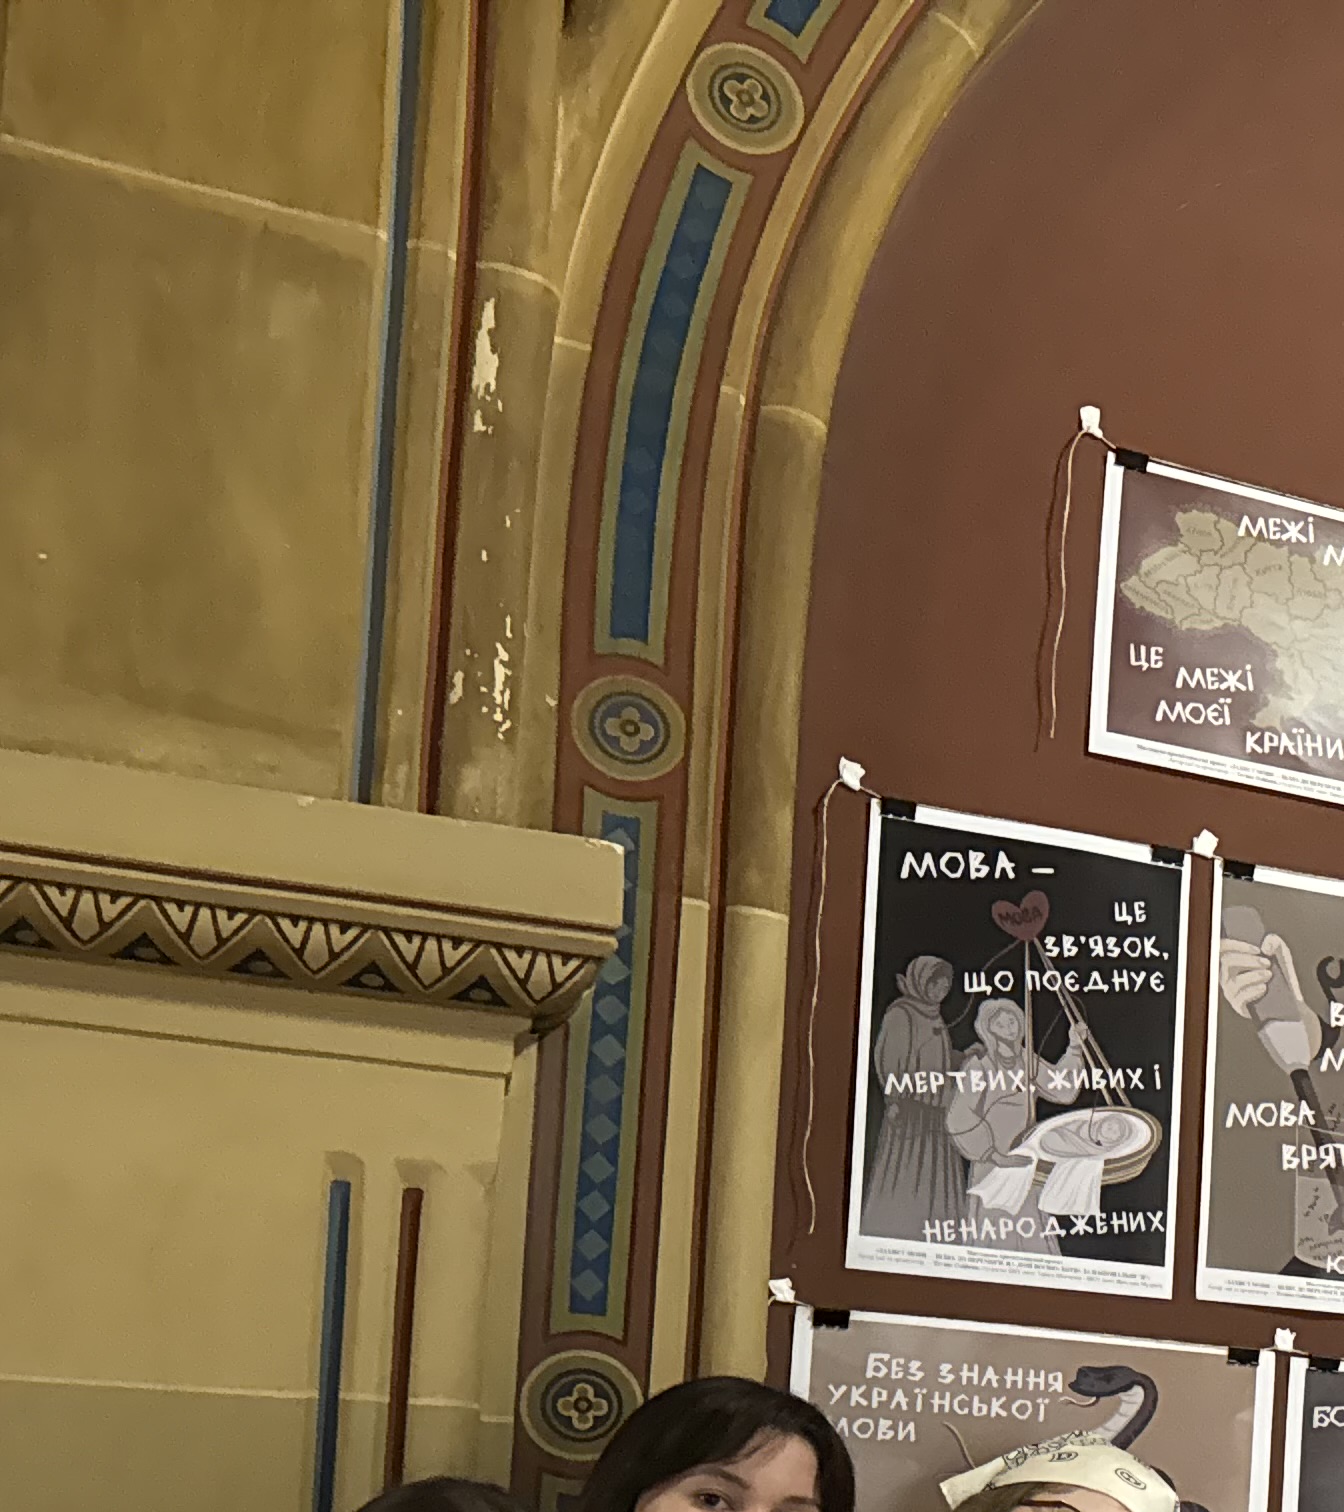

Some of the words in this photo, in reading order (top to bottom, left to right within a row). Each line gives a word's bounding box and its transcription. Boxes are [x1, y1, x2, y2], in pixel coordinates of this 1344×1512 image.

[1238, 515, 1315, 544] МЕЖІ
[1175, 665, 1255, 692] МЕЖІ
[1155, 698, 1232, 726] МОЄЇ
[900, 849, 1017, 880] МОВА
[1026, 969, 1165, 995] ПОЄДНУЄ
[1048, 1066, 1145, 1095] ЖИВИХ
[1225, 1100, 1317, 1129] МОВА
[922, 1208, 1166, 1247] НЕНАРОДЖЕНИХ
[938, 1357, 1064, 1394] ЗНАННЯ
[827, 1383, 1052, 1424] УКРАЇНСЬКОЇ
